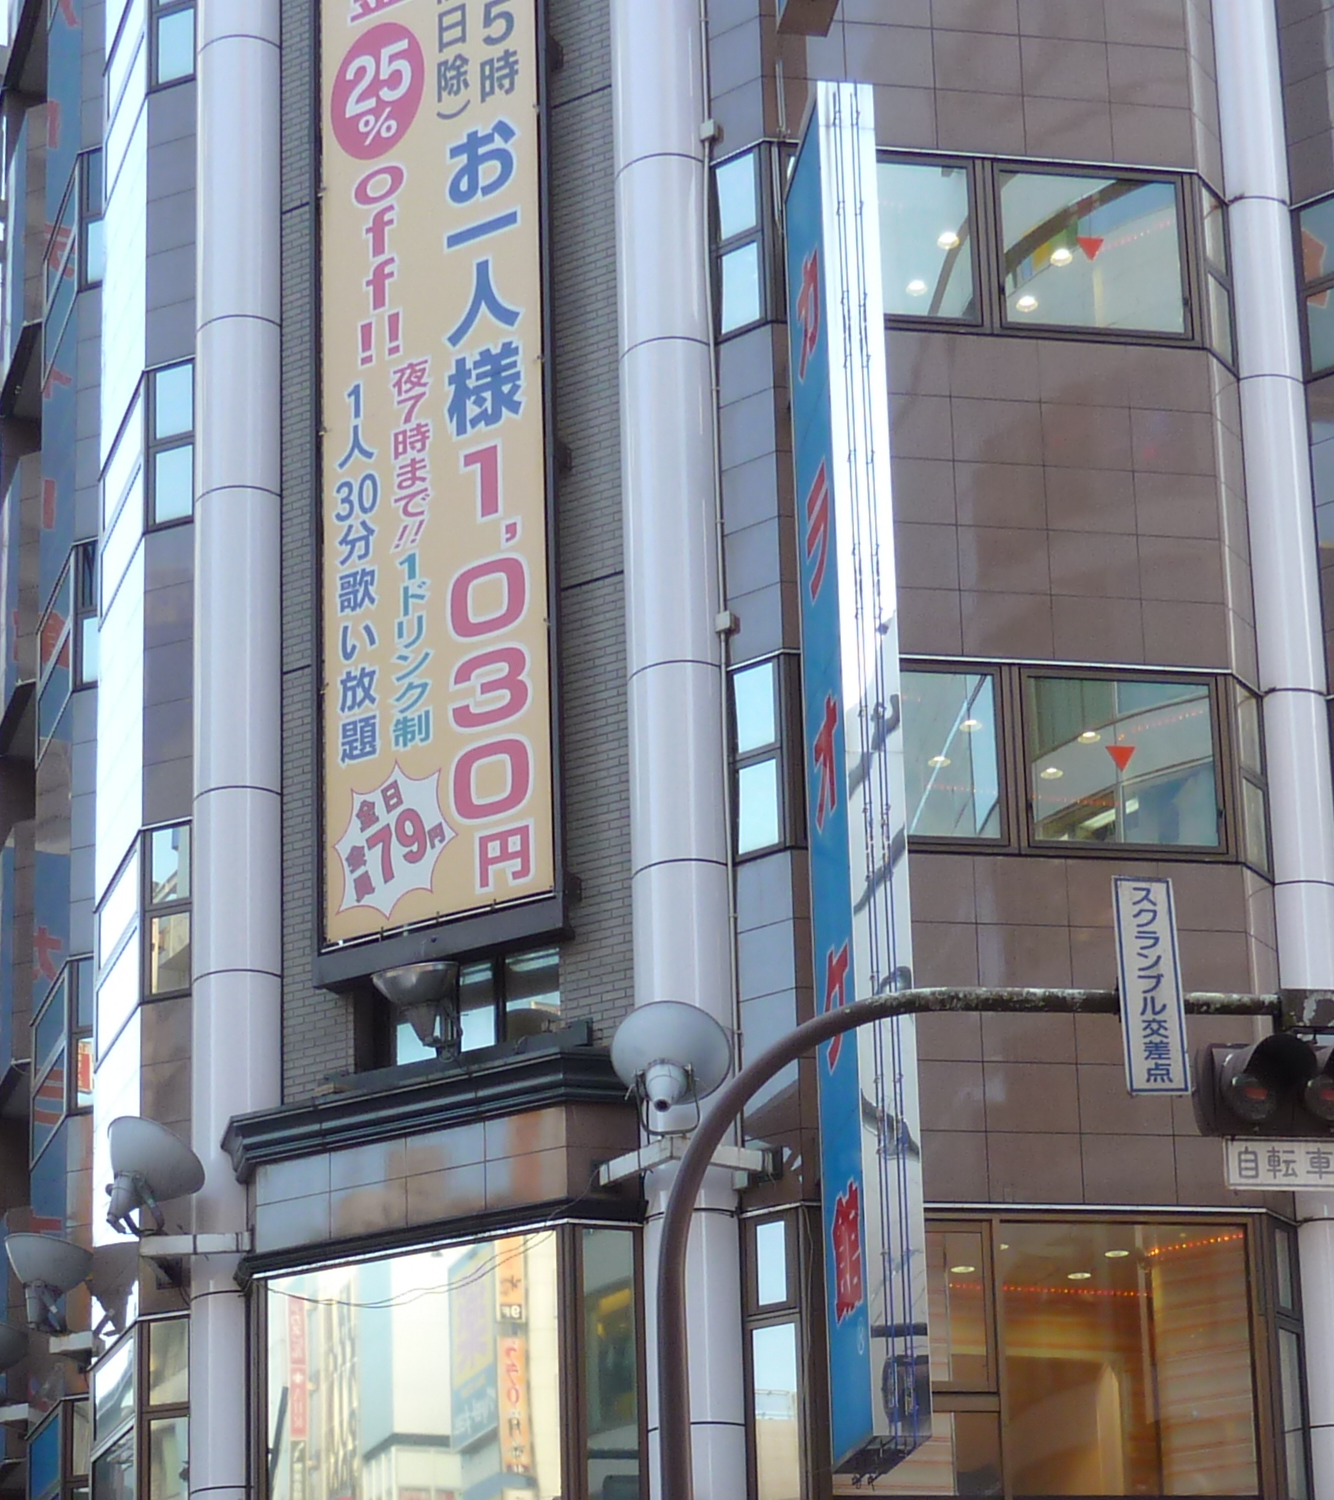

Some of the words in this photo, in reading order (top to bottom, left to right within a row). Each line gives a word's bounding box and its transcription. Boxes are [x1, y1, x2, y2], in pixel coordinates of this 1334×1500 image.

[446, 119, 524, 438] お一人様
[334, 382, 380, 765] 1人30分歌い放題
[392, 552, 434, 750] 1ドリンク制
[449, 444, 531, 892] 1,030円
[355, 780, 404, 833] 全日
[796, 243, 864, 1326] カラオケ館
[1131, 886, 1174, 1084] スクランブル交差点
